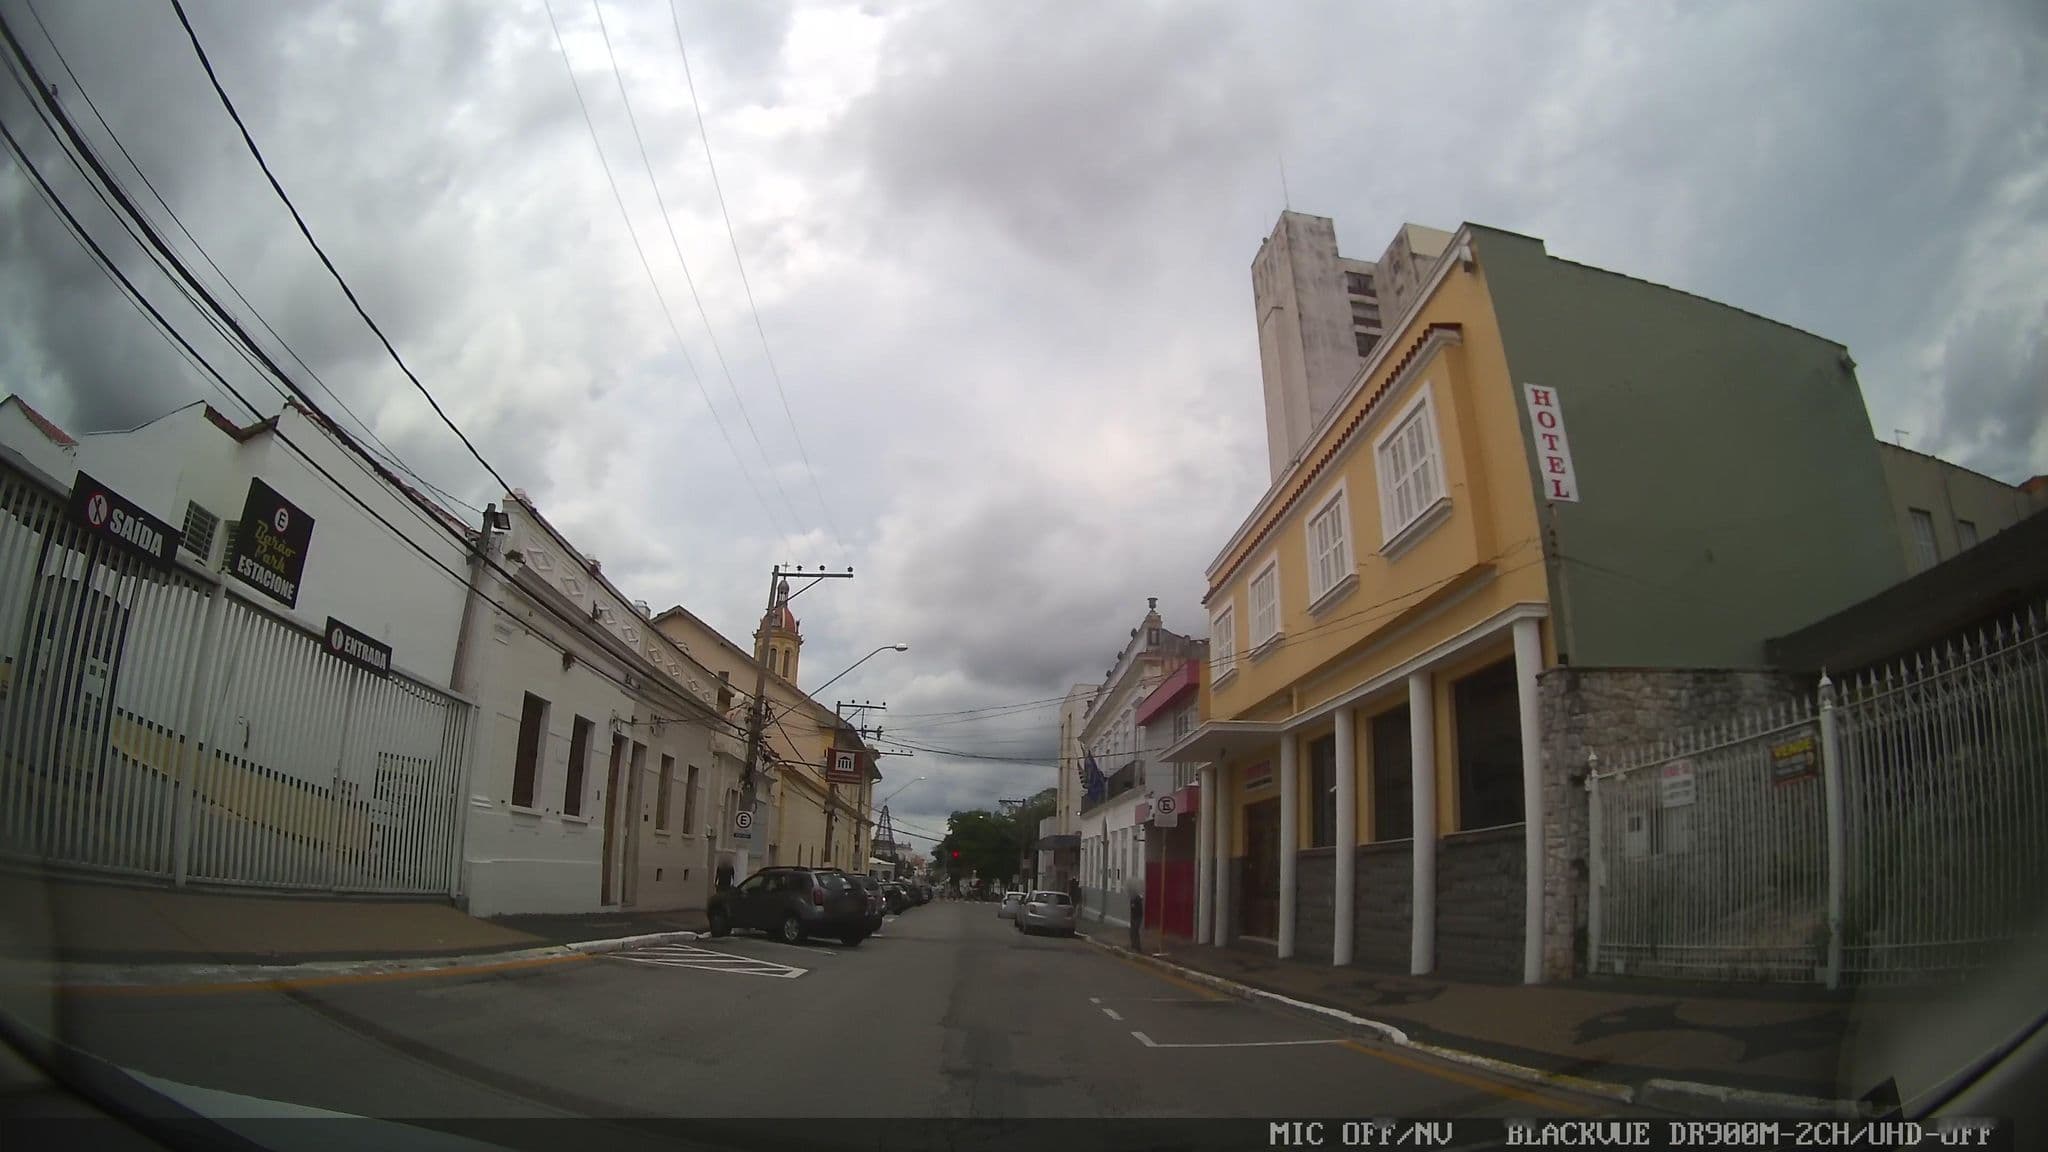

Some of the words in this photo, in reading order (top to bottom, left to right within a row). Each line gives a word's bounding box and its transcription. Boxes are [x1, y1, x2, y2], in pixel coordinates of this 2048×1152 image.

[1532, 387, 1570, 499] HOTEL
[109, 508, 163, 558] SAÍDA
[237, 554, 295, 600] ESTACIONE
[254, 543, 286, 574] Park
[344, 635, 386, 670] ENTRADA
